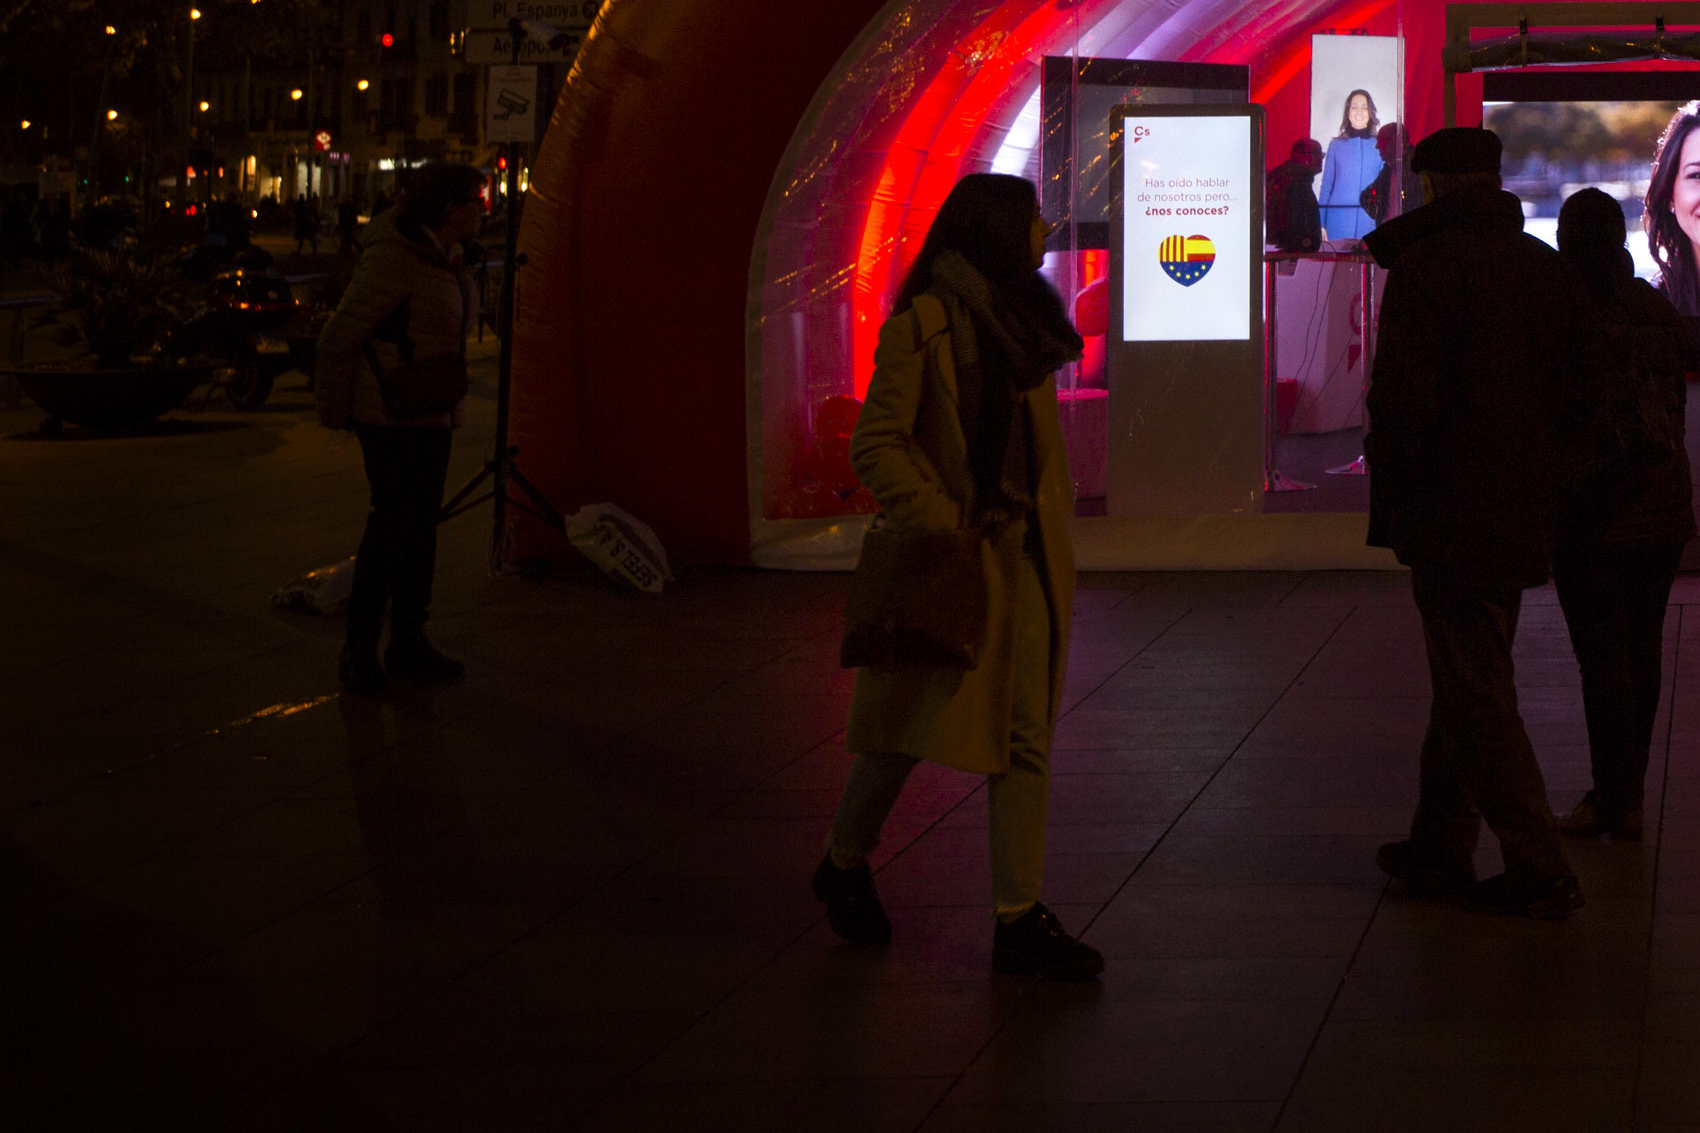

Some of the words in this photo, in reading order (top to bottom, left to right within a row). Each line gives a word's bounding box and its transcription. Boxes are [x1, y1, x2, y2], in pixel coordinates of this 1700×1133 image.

[516, 0, 578, 20] Espanya
[1134, 125, 1151, 137] Cs
[1144, 177, 1166, 188] Has
[1168, 177, 1193, 188] oído
[1195, 177, 1230, 188] hablar
[1137, 192, 1151, 202] de
[1154, 192, 1202, 202] nosotros
[1204, 193, 1239, 204] pero...
[1144, 206, 1172, 217] ¿nos
[1175, 205, 1230, 216] conoces?
